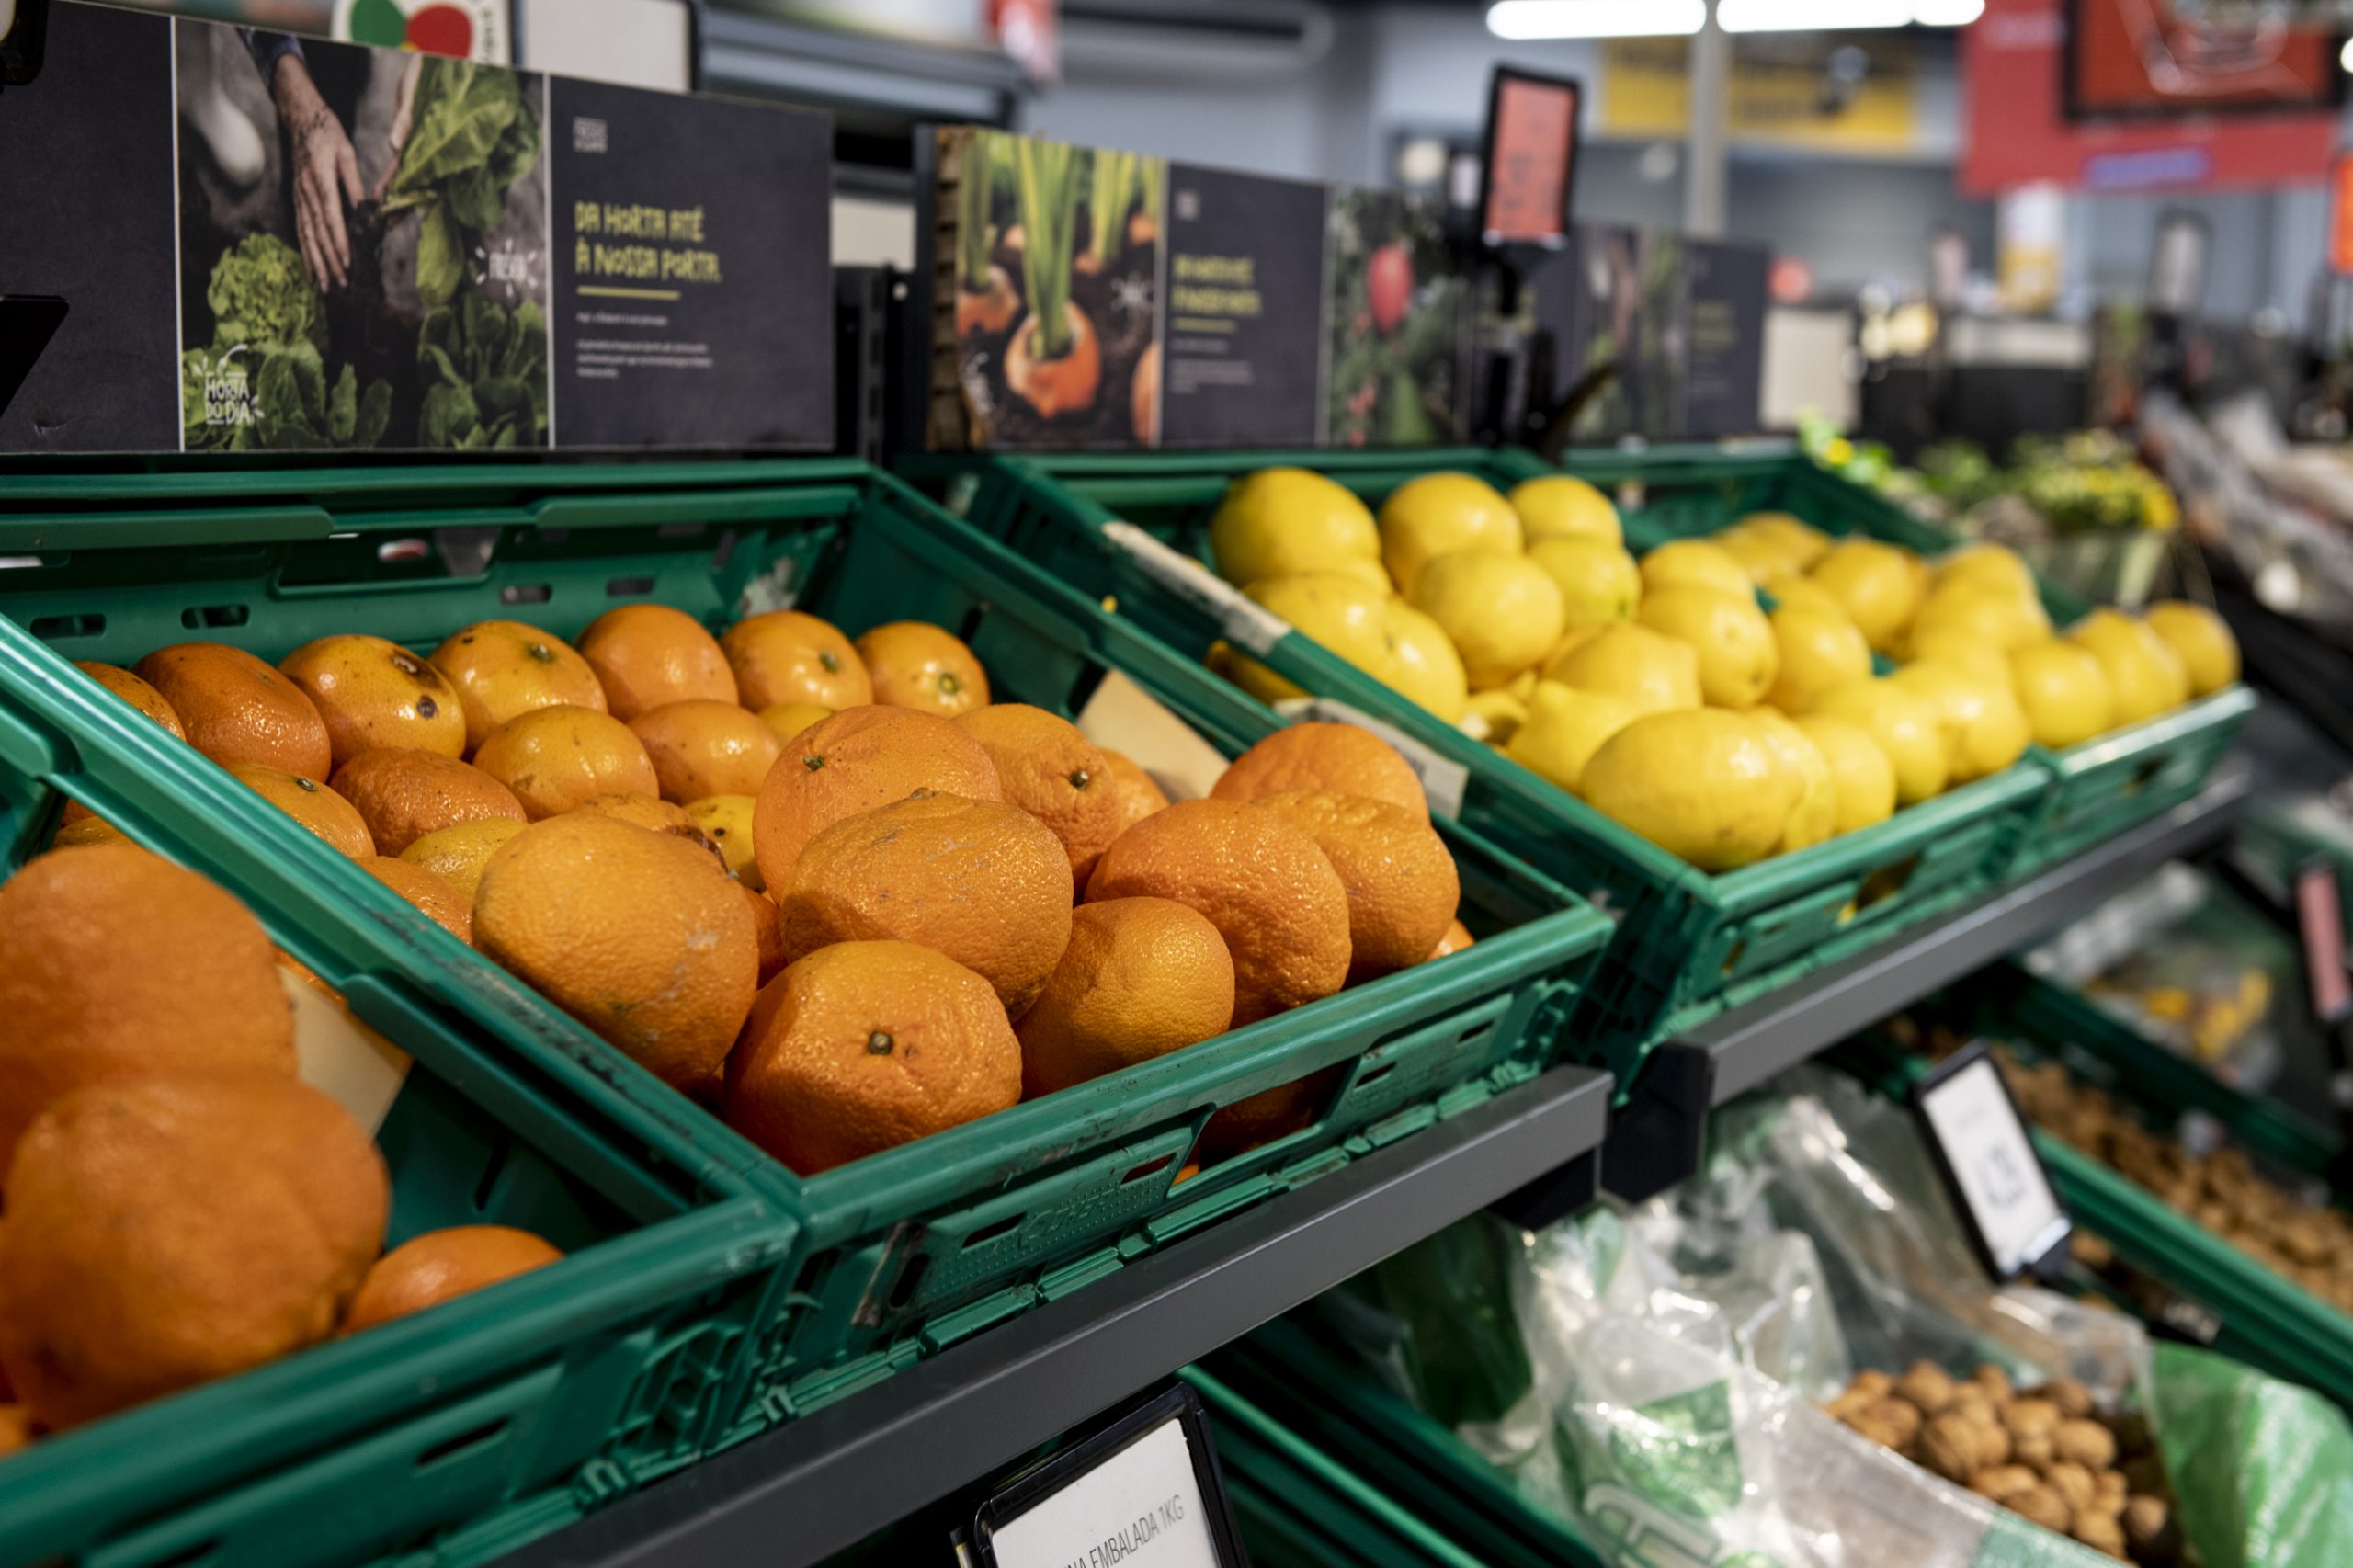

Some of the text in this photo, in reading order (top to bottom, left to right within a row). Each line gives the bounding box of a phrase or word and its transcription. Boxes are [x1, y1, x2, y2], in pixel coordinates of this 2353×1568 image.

[575, 200, 601, 232] DA
[603, 202, 666, 240] HORTA
[594, 243, 659, 278] NOSSA
[205, 375, 250, 400] HORTA
[205, 400, 222, 419] DO
[1089, 1494, 1184, 1568] EMBALADA 1KG
